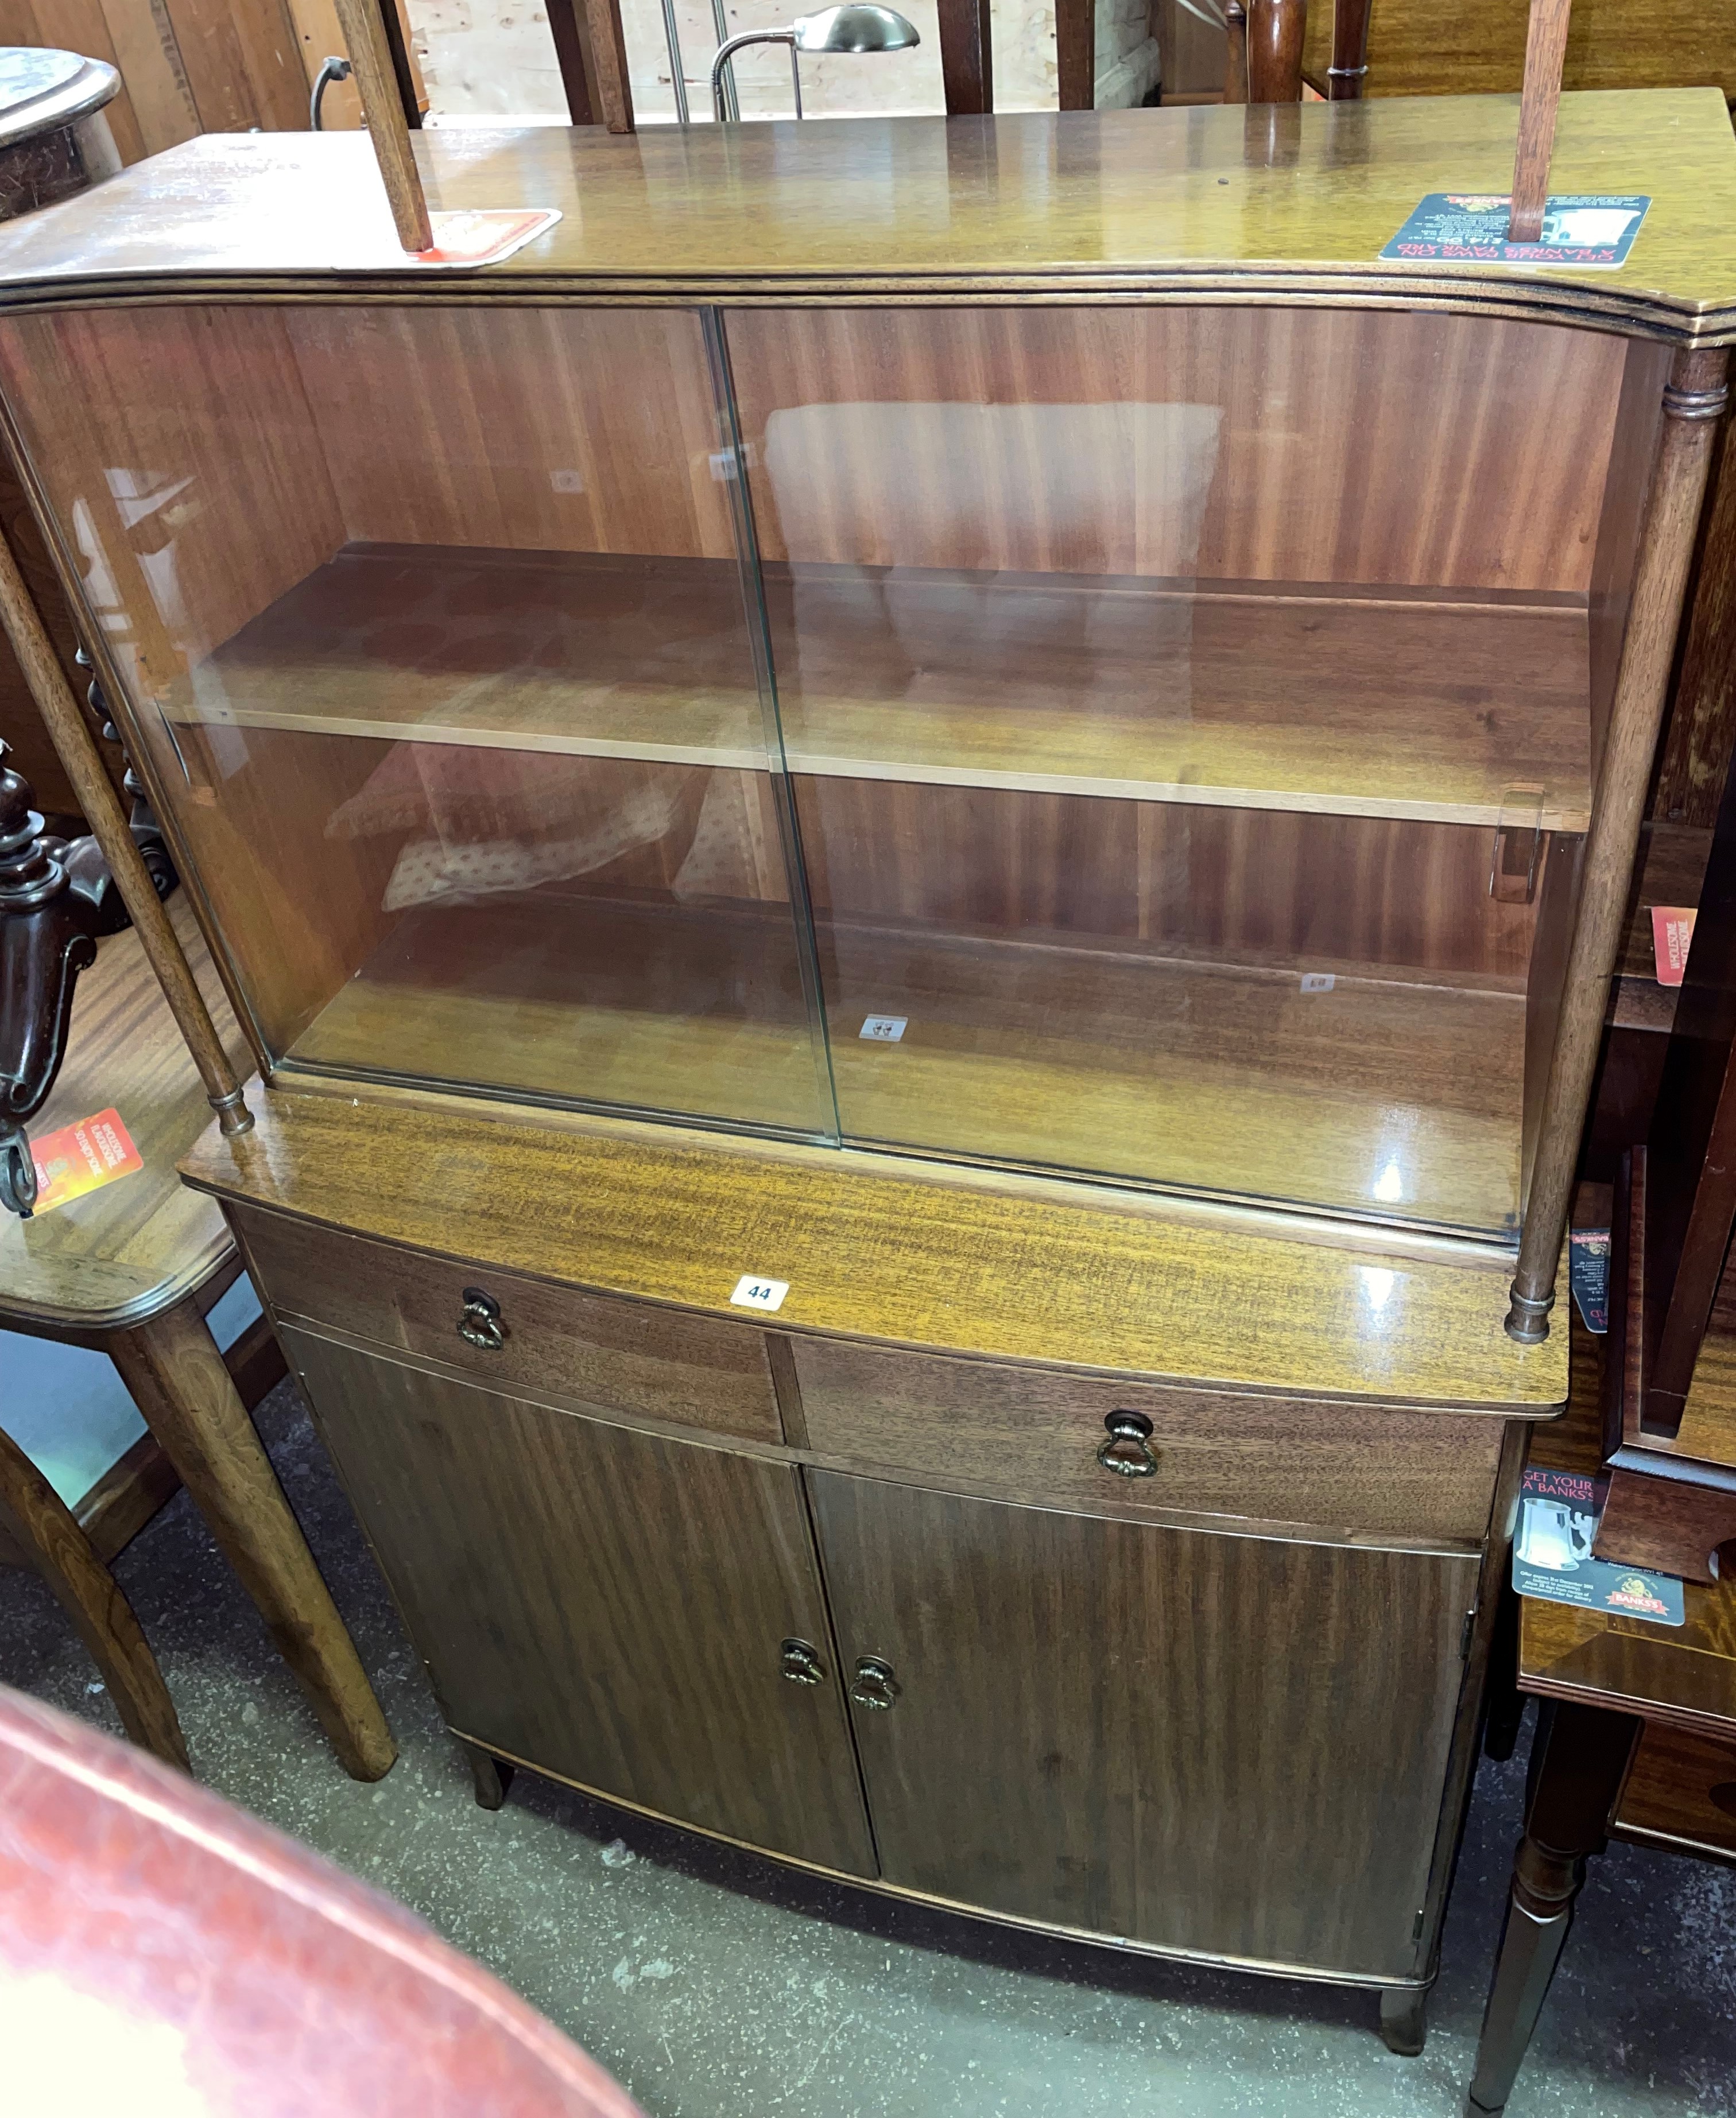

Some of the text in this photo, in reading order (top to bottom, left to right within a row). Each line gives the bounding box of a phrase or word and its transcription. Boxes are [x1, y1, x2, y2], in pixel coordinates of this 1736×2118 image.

[74, 1130, 86, 1140] SO
[79, 1139, 95, 1159] ENJOY
[747, 1286, 772, 1300] 44
[1522, 1480, 1533, 1490] A
[1523, 1470, 1593, 1492] GET YOUR
[1615, 1594, 1658, 1608] BANKS'S
